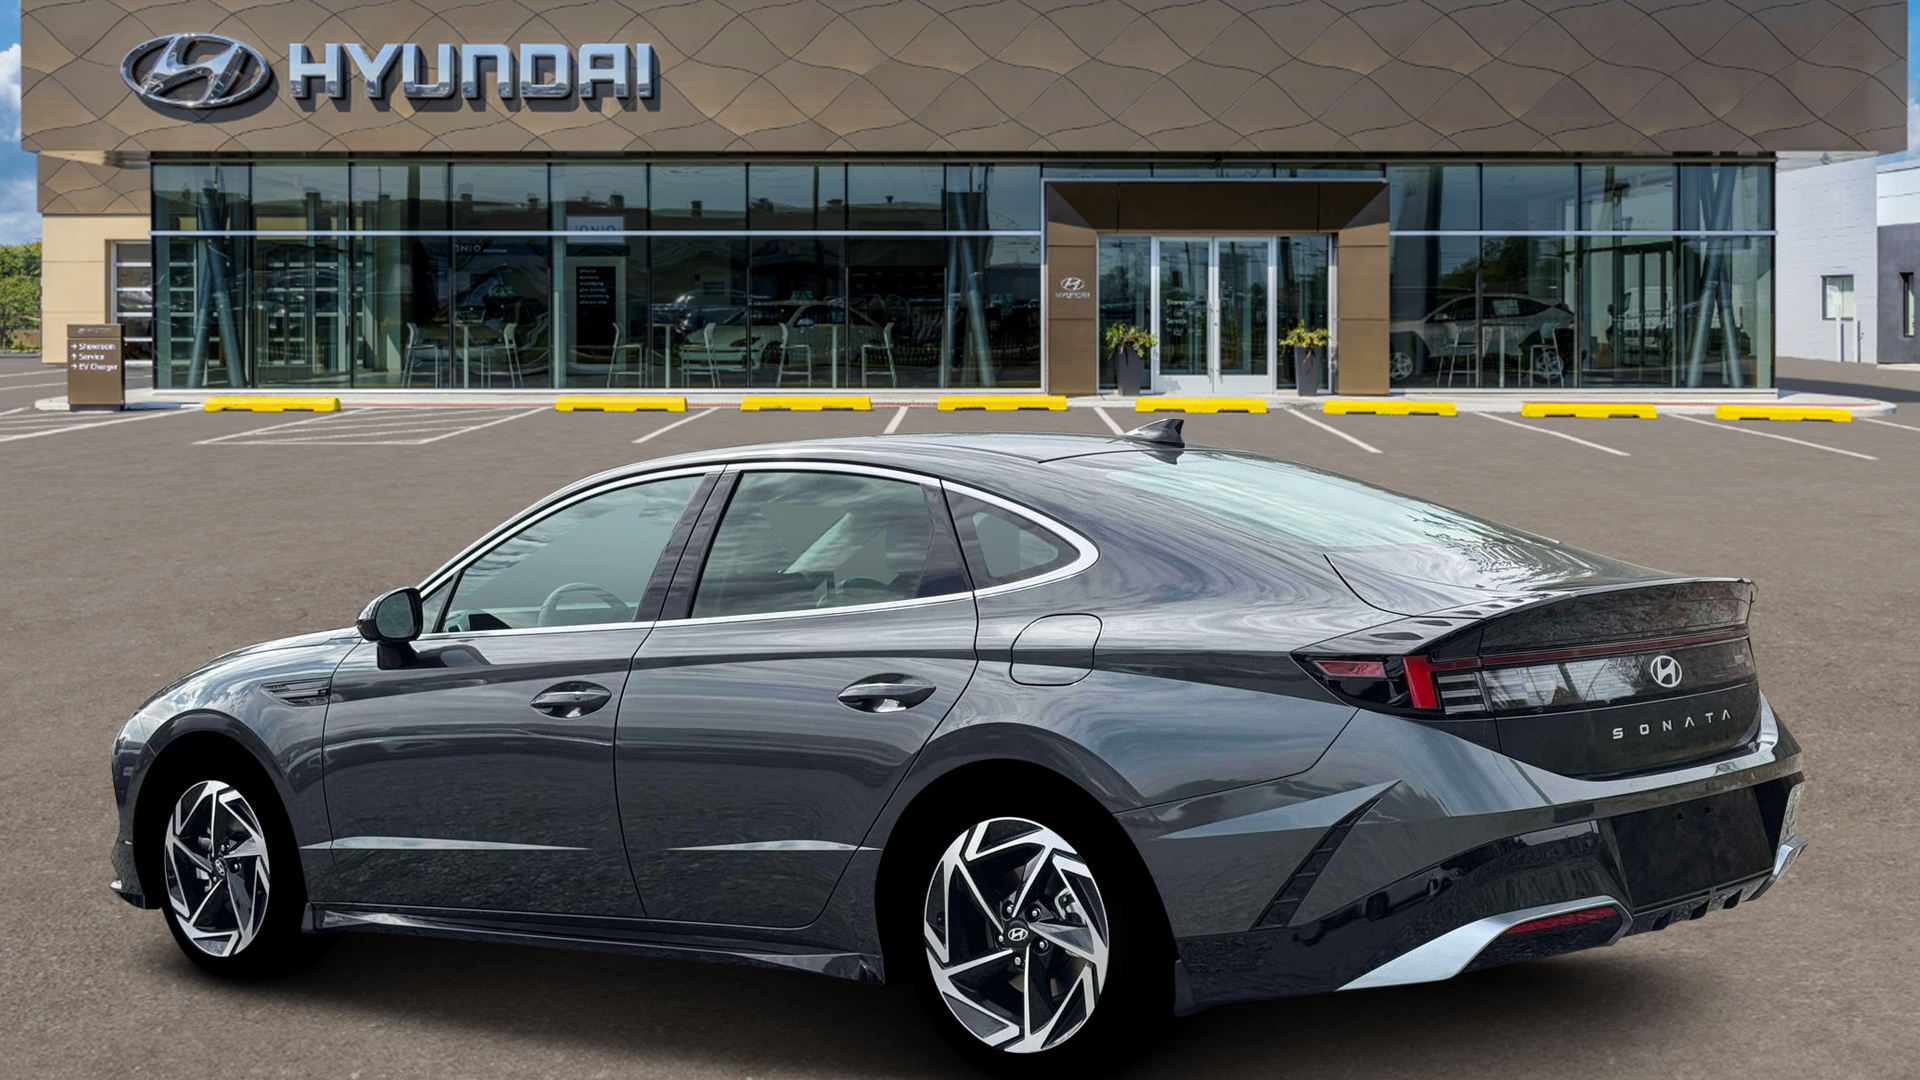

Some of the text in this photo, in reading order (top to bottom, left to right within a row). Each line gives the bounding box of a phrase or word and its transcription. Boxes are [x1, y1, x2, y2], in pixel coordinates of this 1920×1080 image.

[288, 42, 654, 100] HYUNDAI
[78, 352, 105, 360] Service
[90, 363, 118, 372] Charger
[1612, 709, 1731, 740] SONATA
